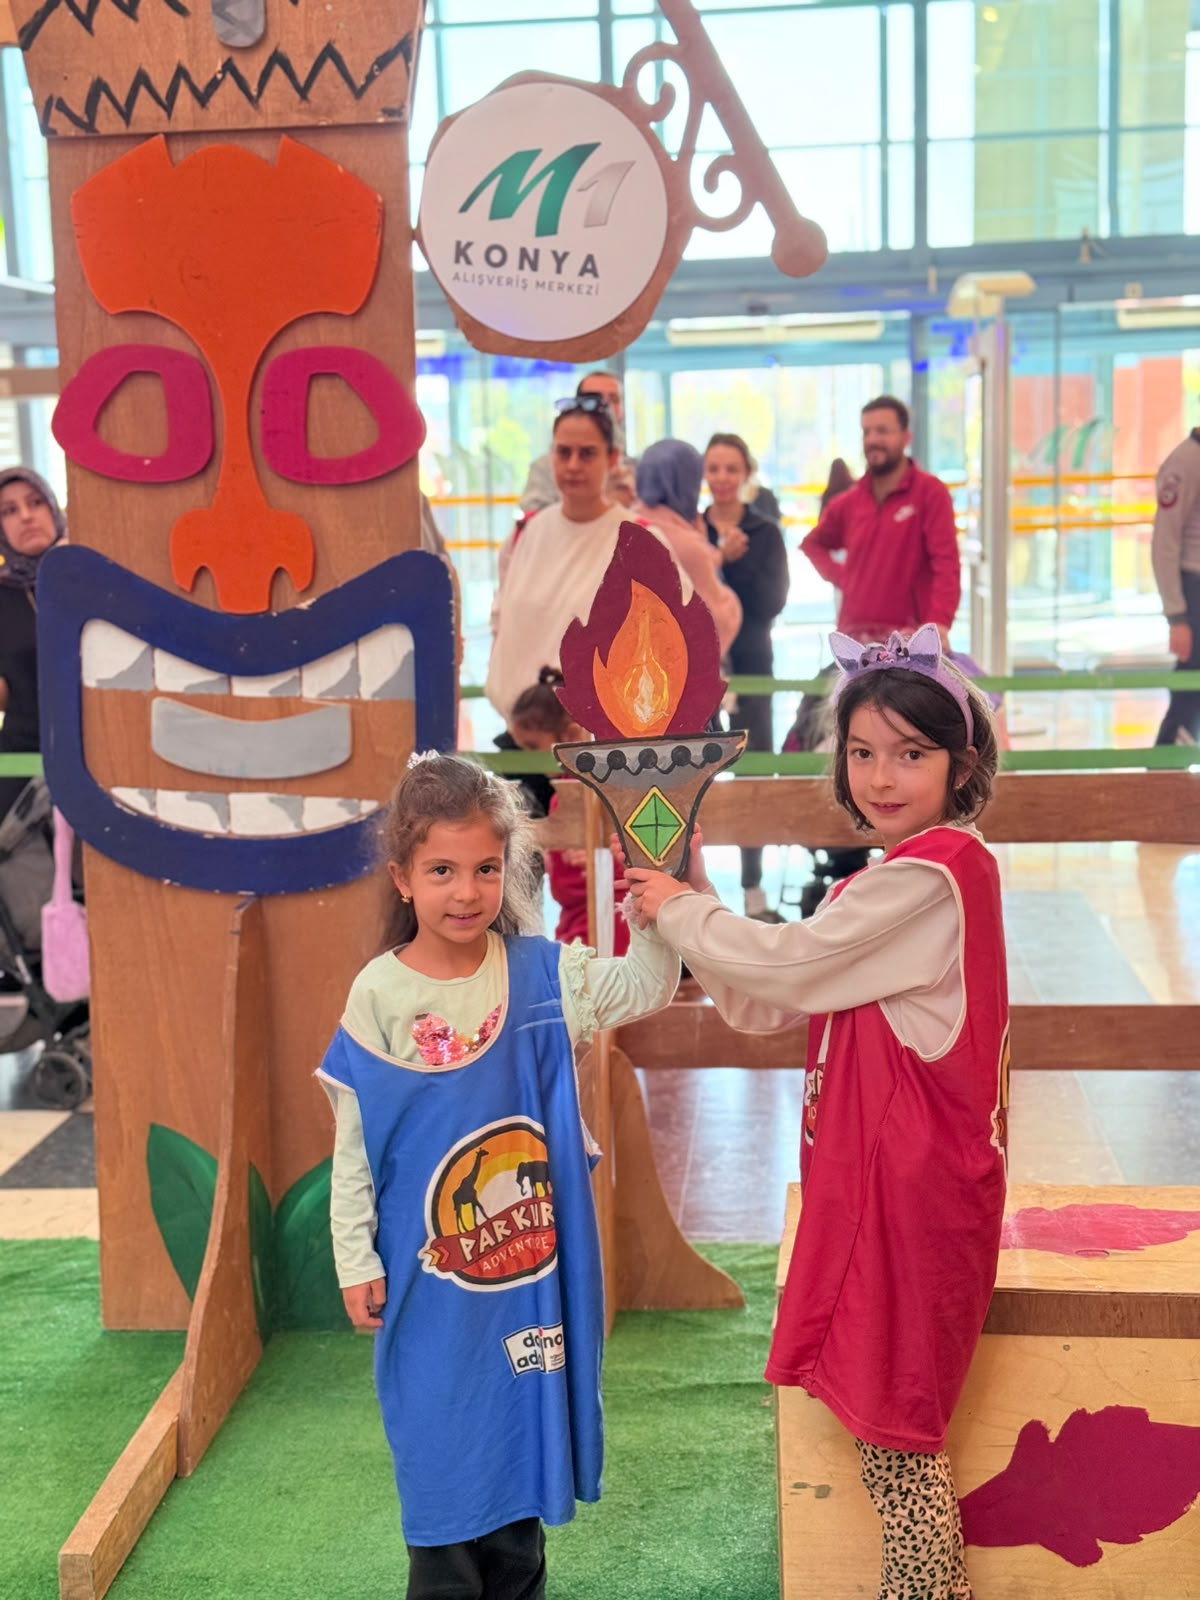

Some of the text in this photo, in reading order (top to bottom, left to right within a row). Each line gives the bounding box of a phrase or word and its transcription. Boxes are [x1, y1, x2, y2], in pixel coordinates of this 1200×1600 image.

[458, 142, 636, 238] M1
[454, 240, 600, 278] KONYA
[452, 272, 600, 297] ALIŞVERİŞ MERKEZİ
[458, 1201, 555, 1262] PARKUR
